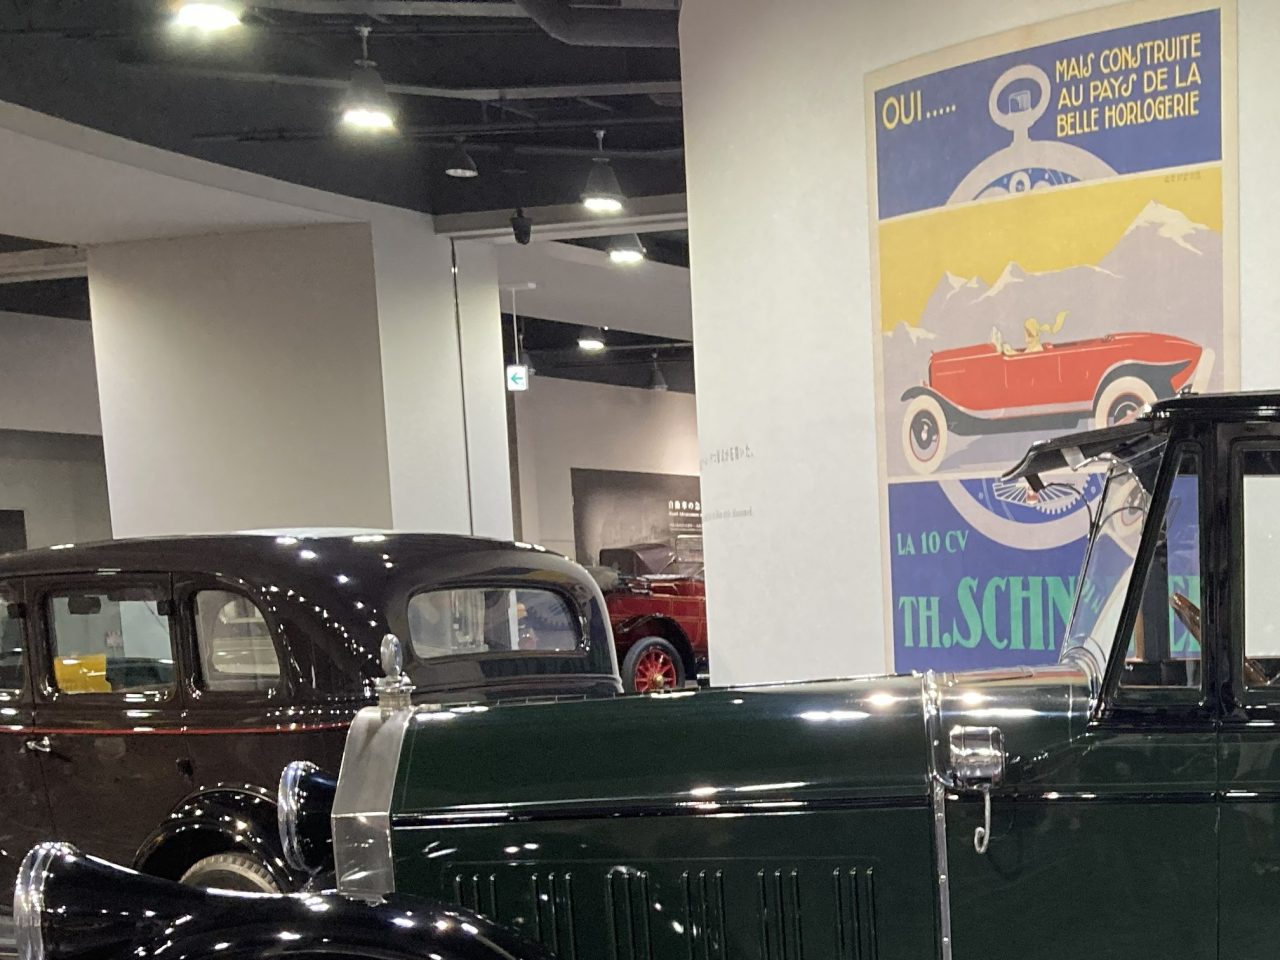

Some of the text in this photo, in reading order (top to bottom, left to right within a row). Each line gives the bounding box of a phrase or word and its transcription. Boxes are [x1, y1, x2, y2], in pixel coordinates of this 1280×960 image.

[1056, 32, 1201, 83] MAIS CONSTRUITE
[1058, 62, 1202, 110] AU PAYS DE LA
[1057, 90, 1200, 138] BELLE HORLOGERIE
[897, 529, 969, 556] LA 10 CV
